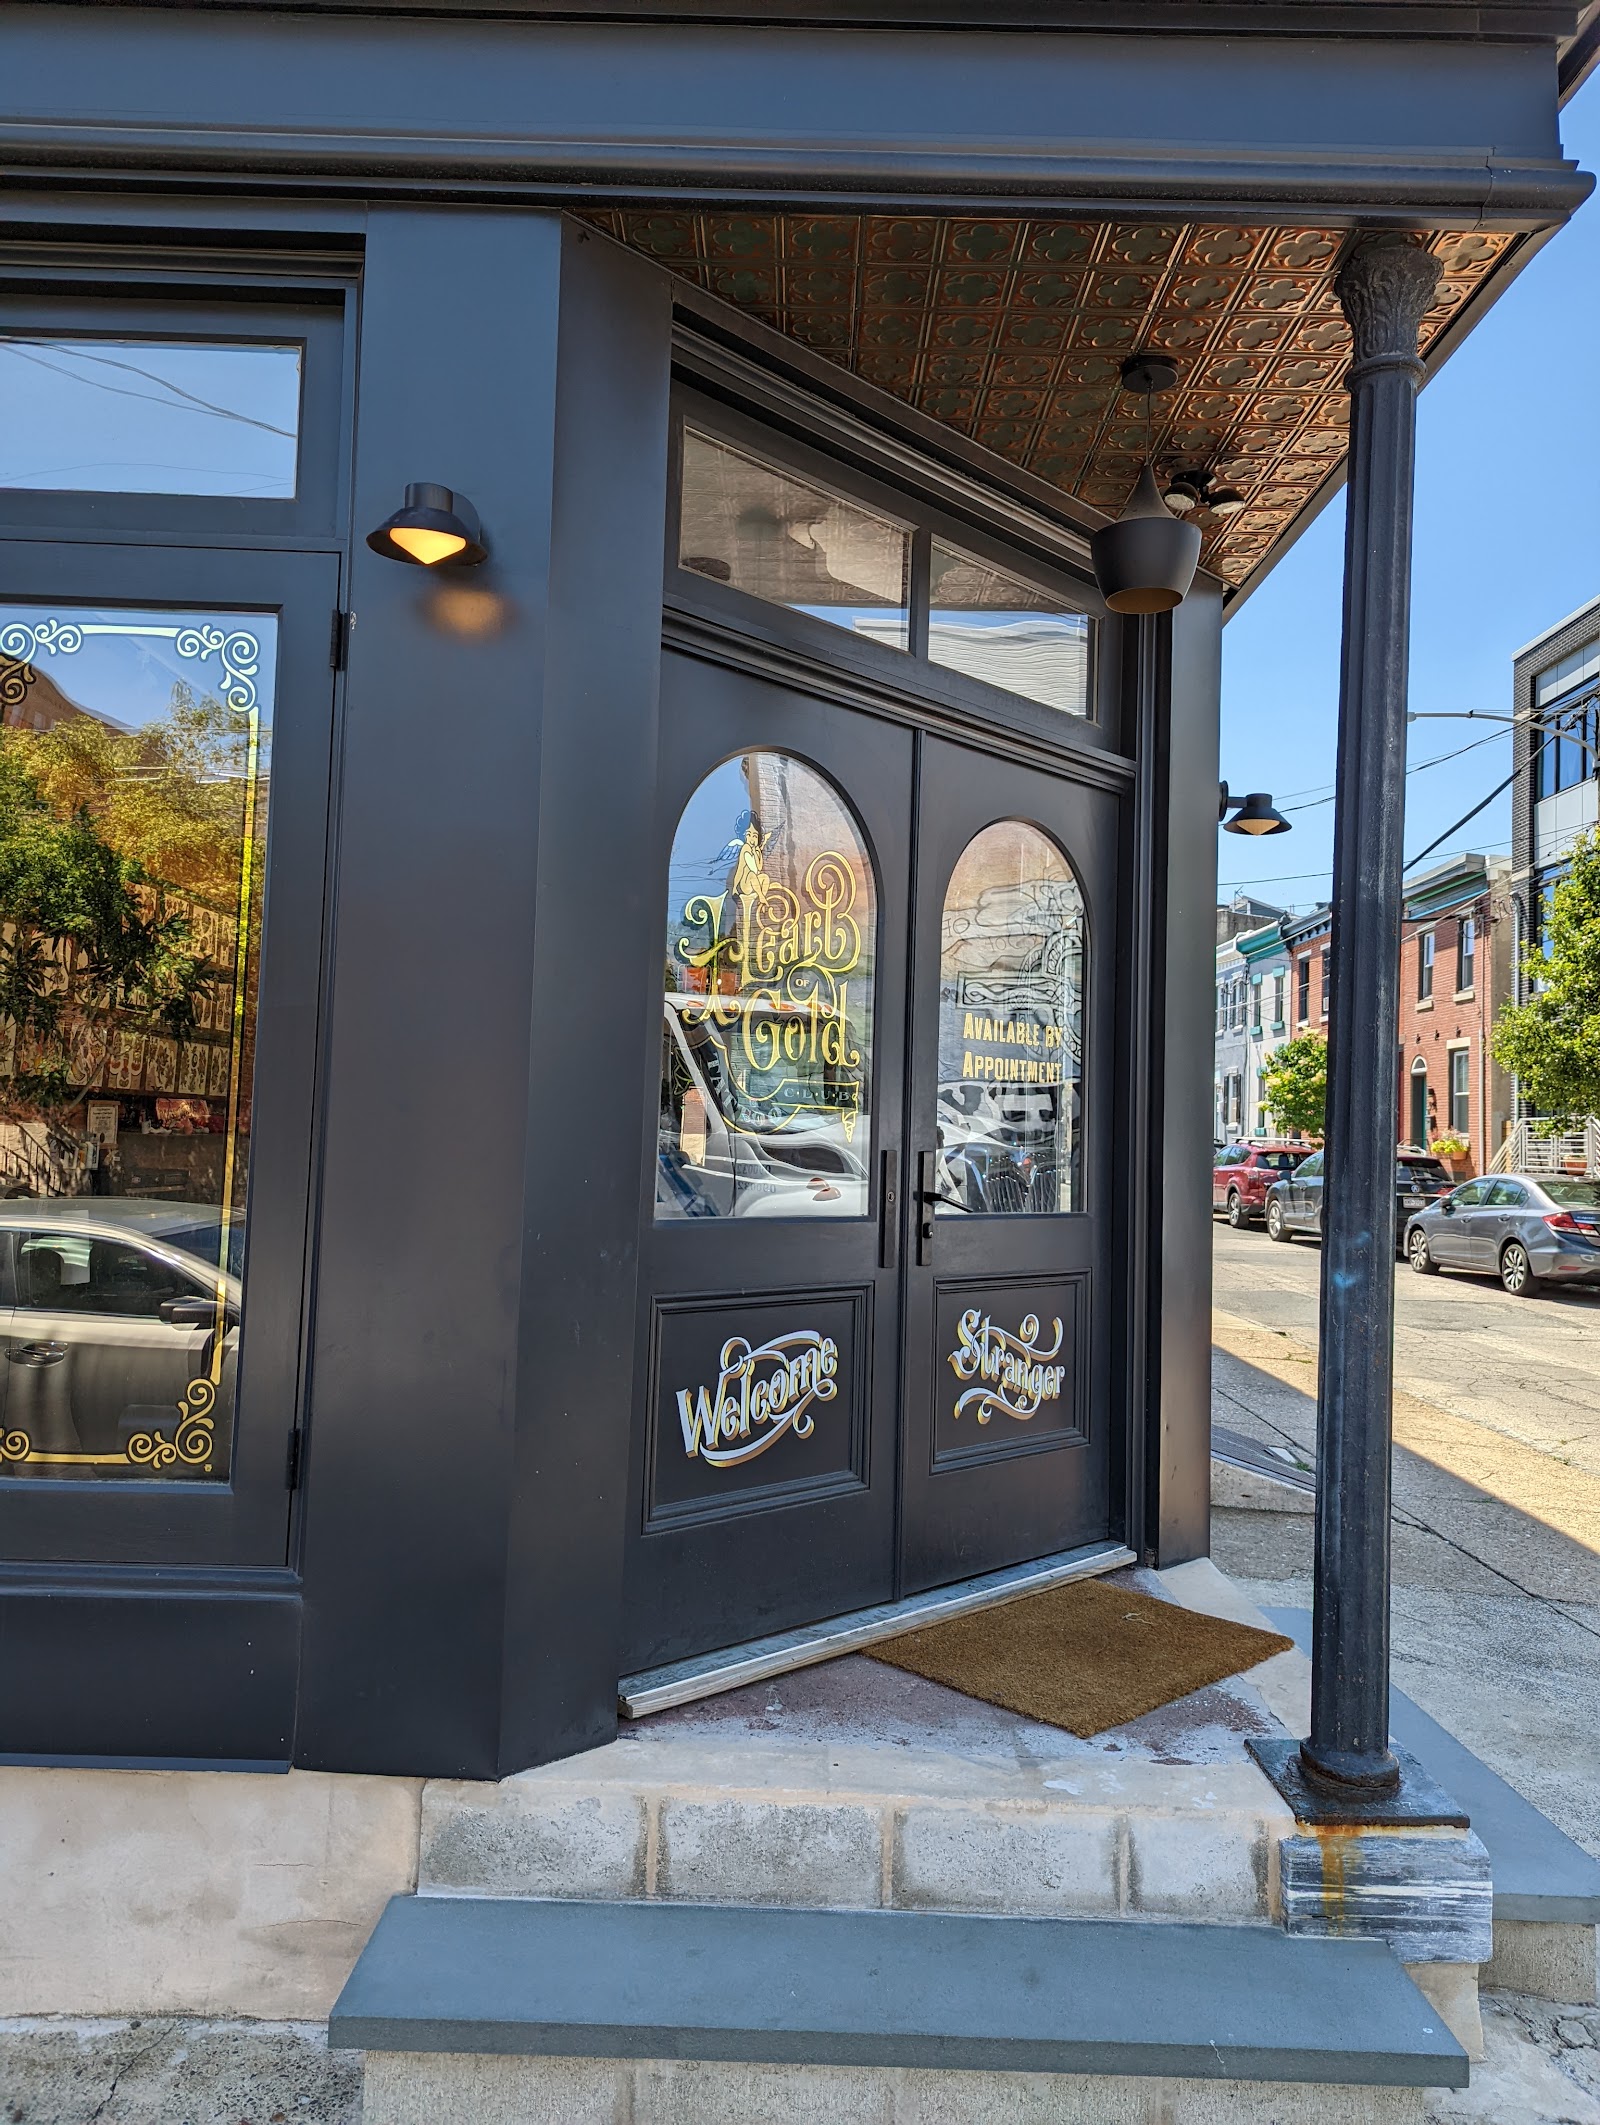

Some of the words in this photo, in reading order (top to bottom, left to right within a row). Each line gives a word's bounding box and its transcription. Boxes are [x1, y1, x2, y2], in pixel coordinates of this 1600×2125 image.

[678, 851, 861, 1026] Heart
[795, 978, 810, 987] OF
[742, 964, 861, 1072] Gold
[962, 1051, 1062, 1084] APPOINTMENT
[963, 1012, 1040, 1046] AVAILABLE
[1045, 1025, 1063, 1048] BY
[675, 1330, 839, 1468] Welcome
[947, 1308, 1066, 1425] Stranger
